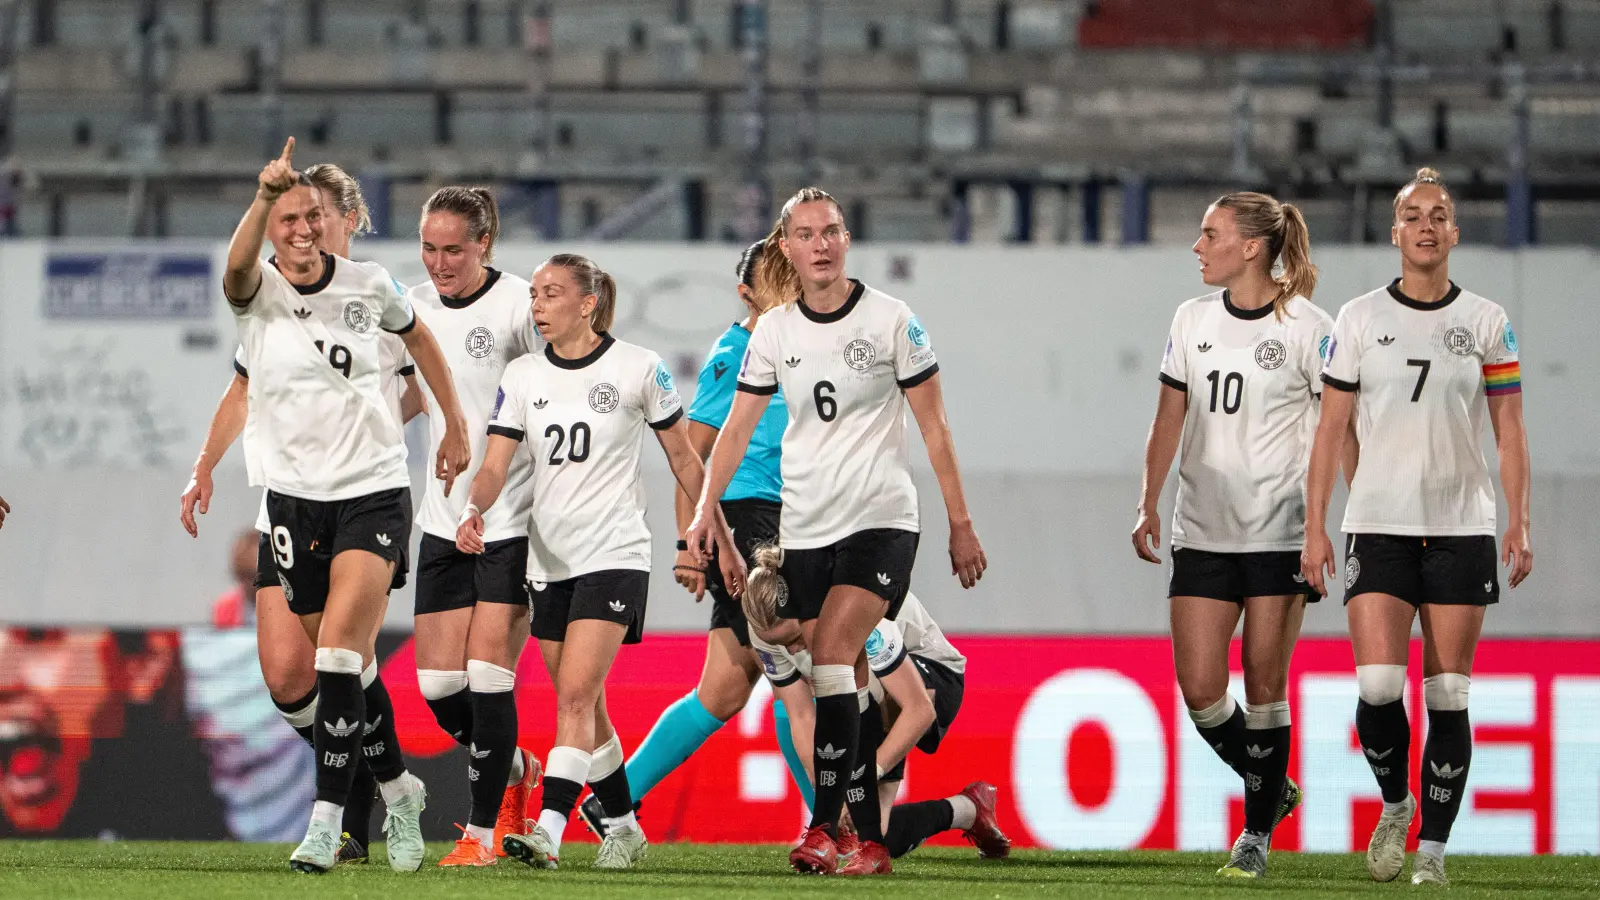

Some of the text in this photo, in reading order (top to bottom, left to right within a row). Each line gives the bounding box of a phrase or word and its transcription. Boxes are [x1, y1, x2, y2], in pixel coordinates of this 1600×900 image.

[813, 380, 838, 423] 6
[1206, 370, 1244, 415] 10
[1406, 359, 1431, 402] 7
[544, 421, 591, 466] 20
[270, 525, 294, 569] 9
[1010, 667, 1600, 855] OFFE
